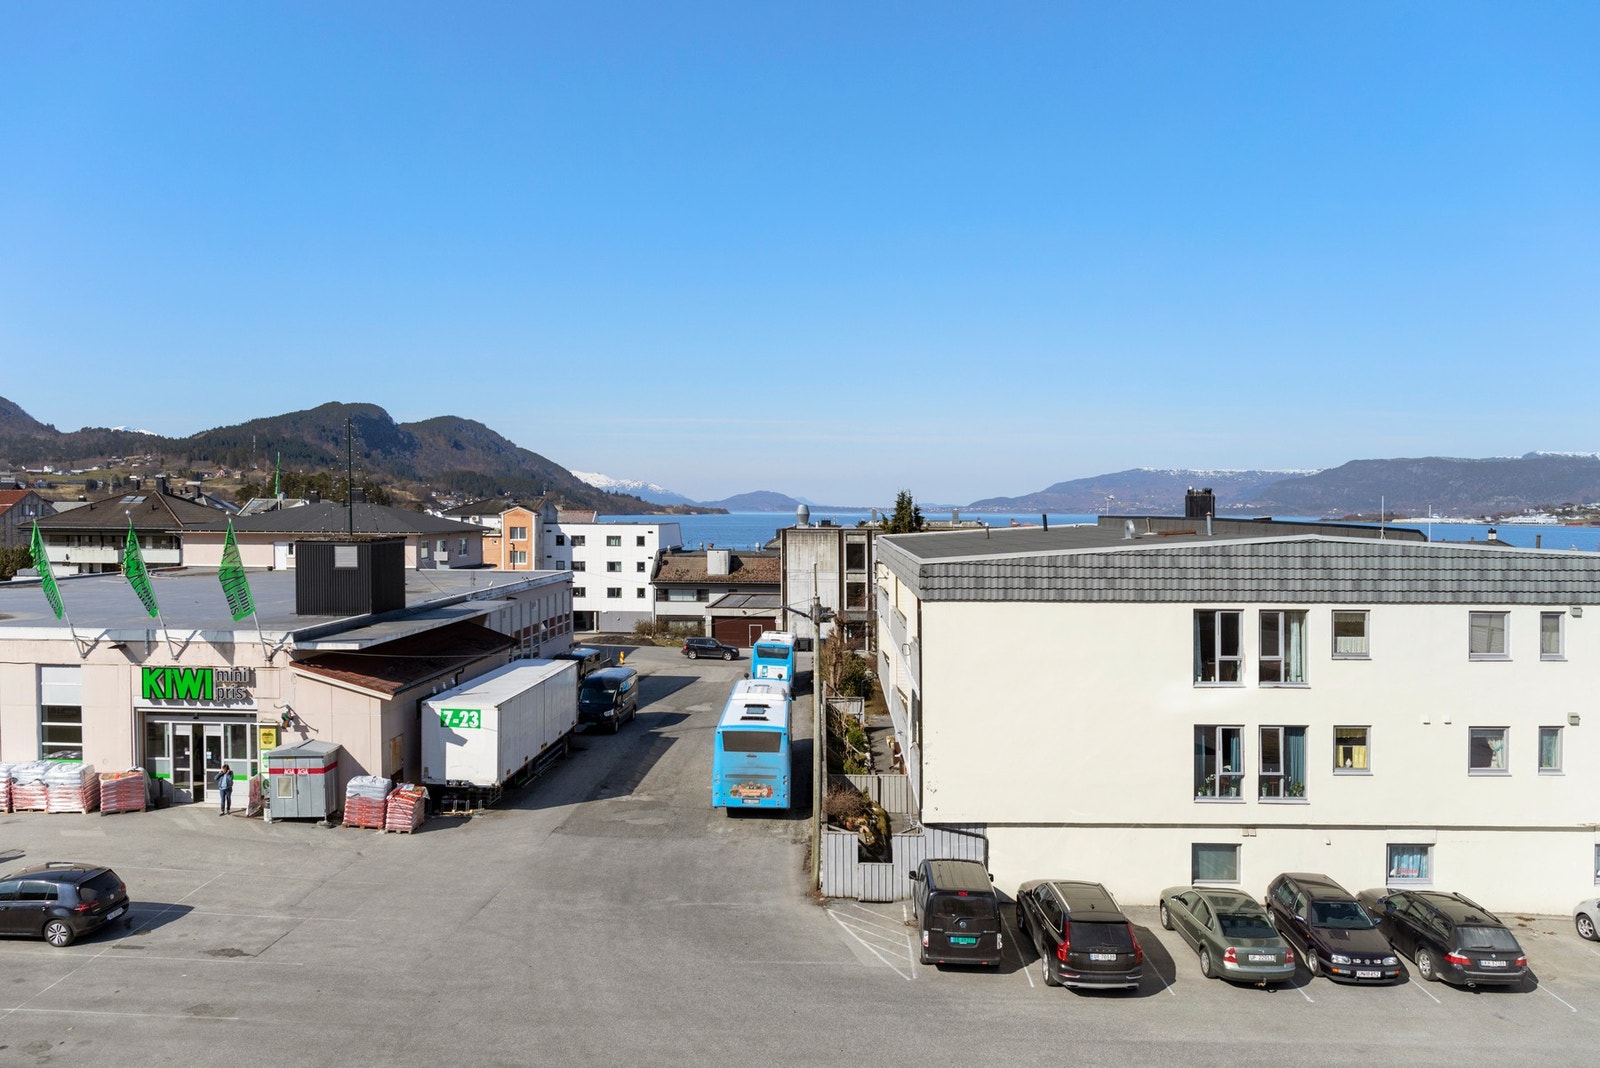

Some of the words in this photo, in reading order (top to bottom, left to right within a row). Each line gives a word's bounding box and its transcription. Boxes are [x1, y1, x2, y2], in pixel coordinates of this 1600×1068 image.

[237, 588, 251, 612] mini
[142, 667, 213, 699] KIWI
[216, 667, 249, 682] mini
[216, 685, 246, 702] pris
[442, 710, 479, 728] 7-23
